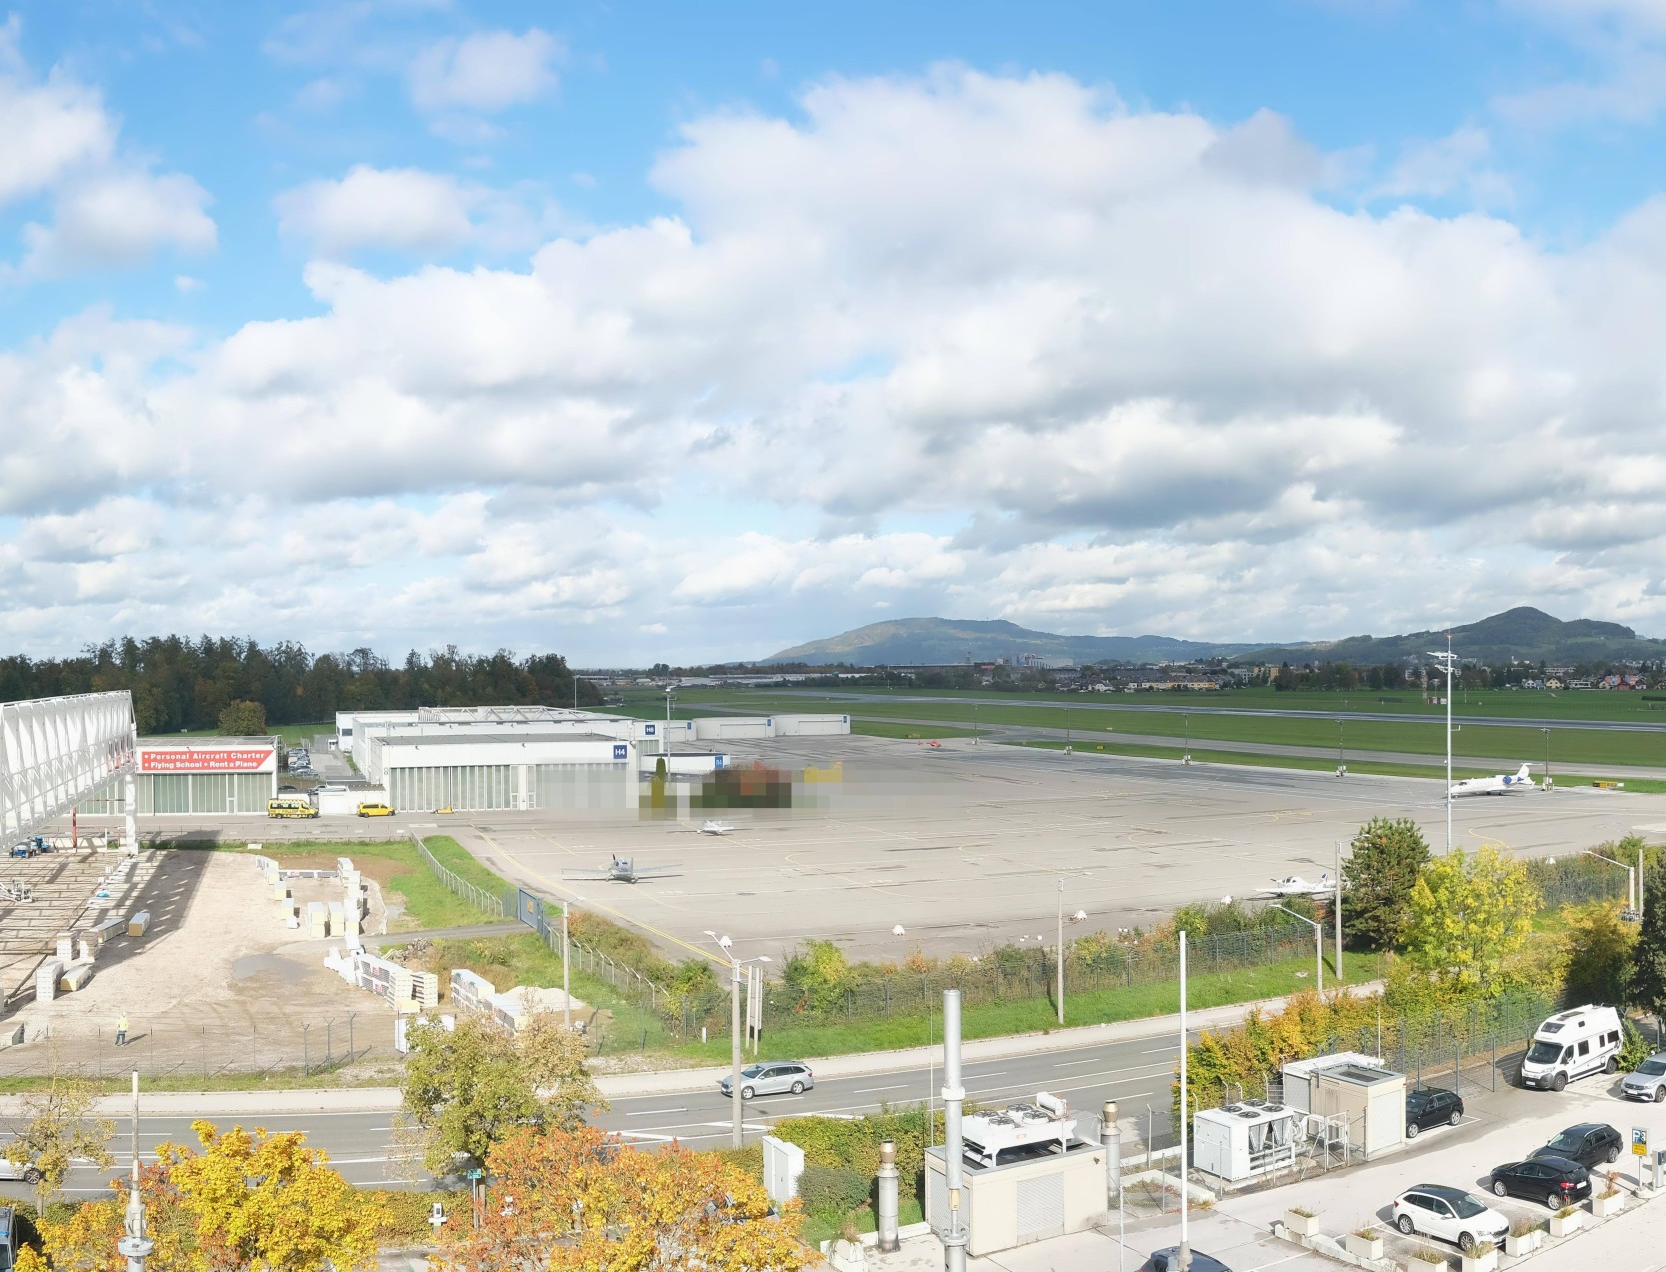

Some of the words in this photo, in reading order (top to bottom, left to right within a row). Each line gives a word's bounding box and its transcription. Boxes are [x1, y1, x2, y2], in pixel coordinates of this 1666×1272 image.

[192, 752, 228, 760] Aircraft
[230, 751, 265, 759] Charter
[615, 748, 626, 756] H4
[150, 761, 174, 769] Flying
[209, 760, 228, 768] Rent
[235, 760, 258, 768] Plane
